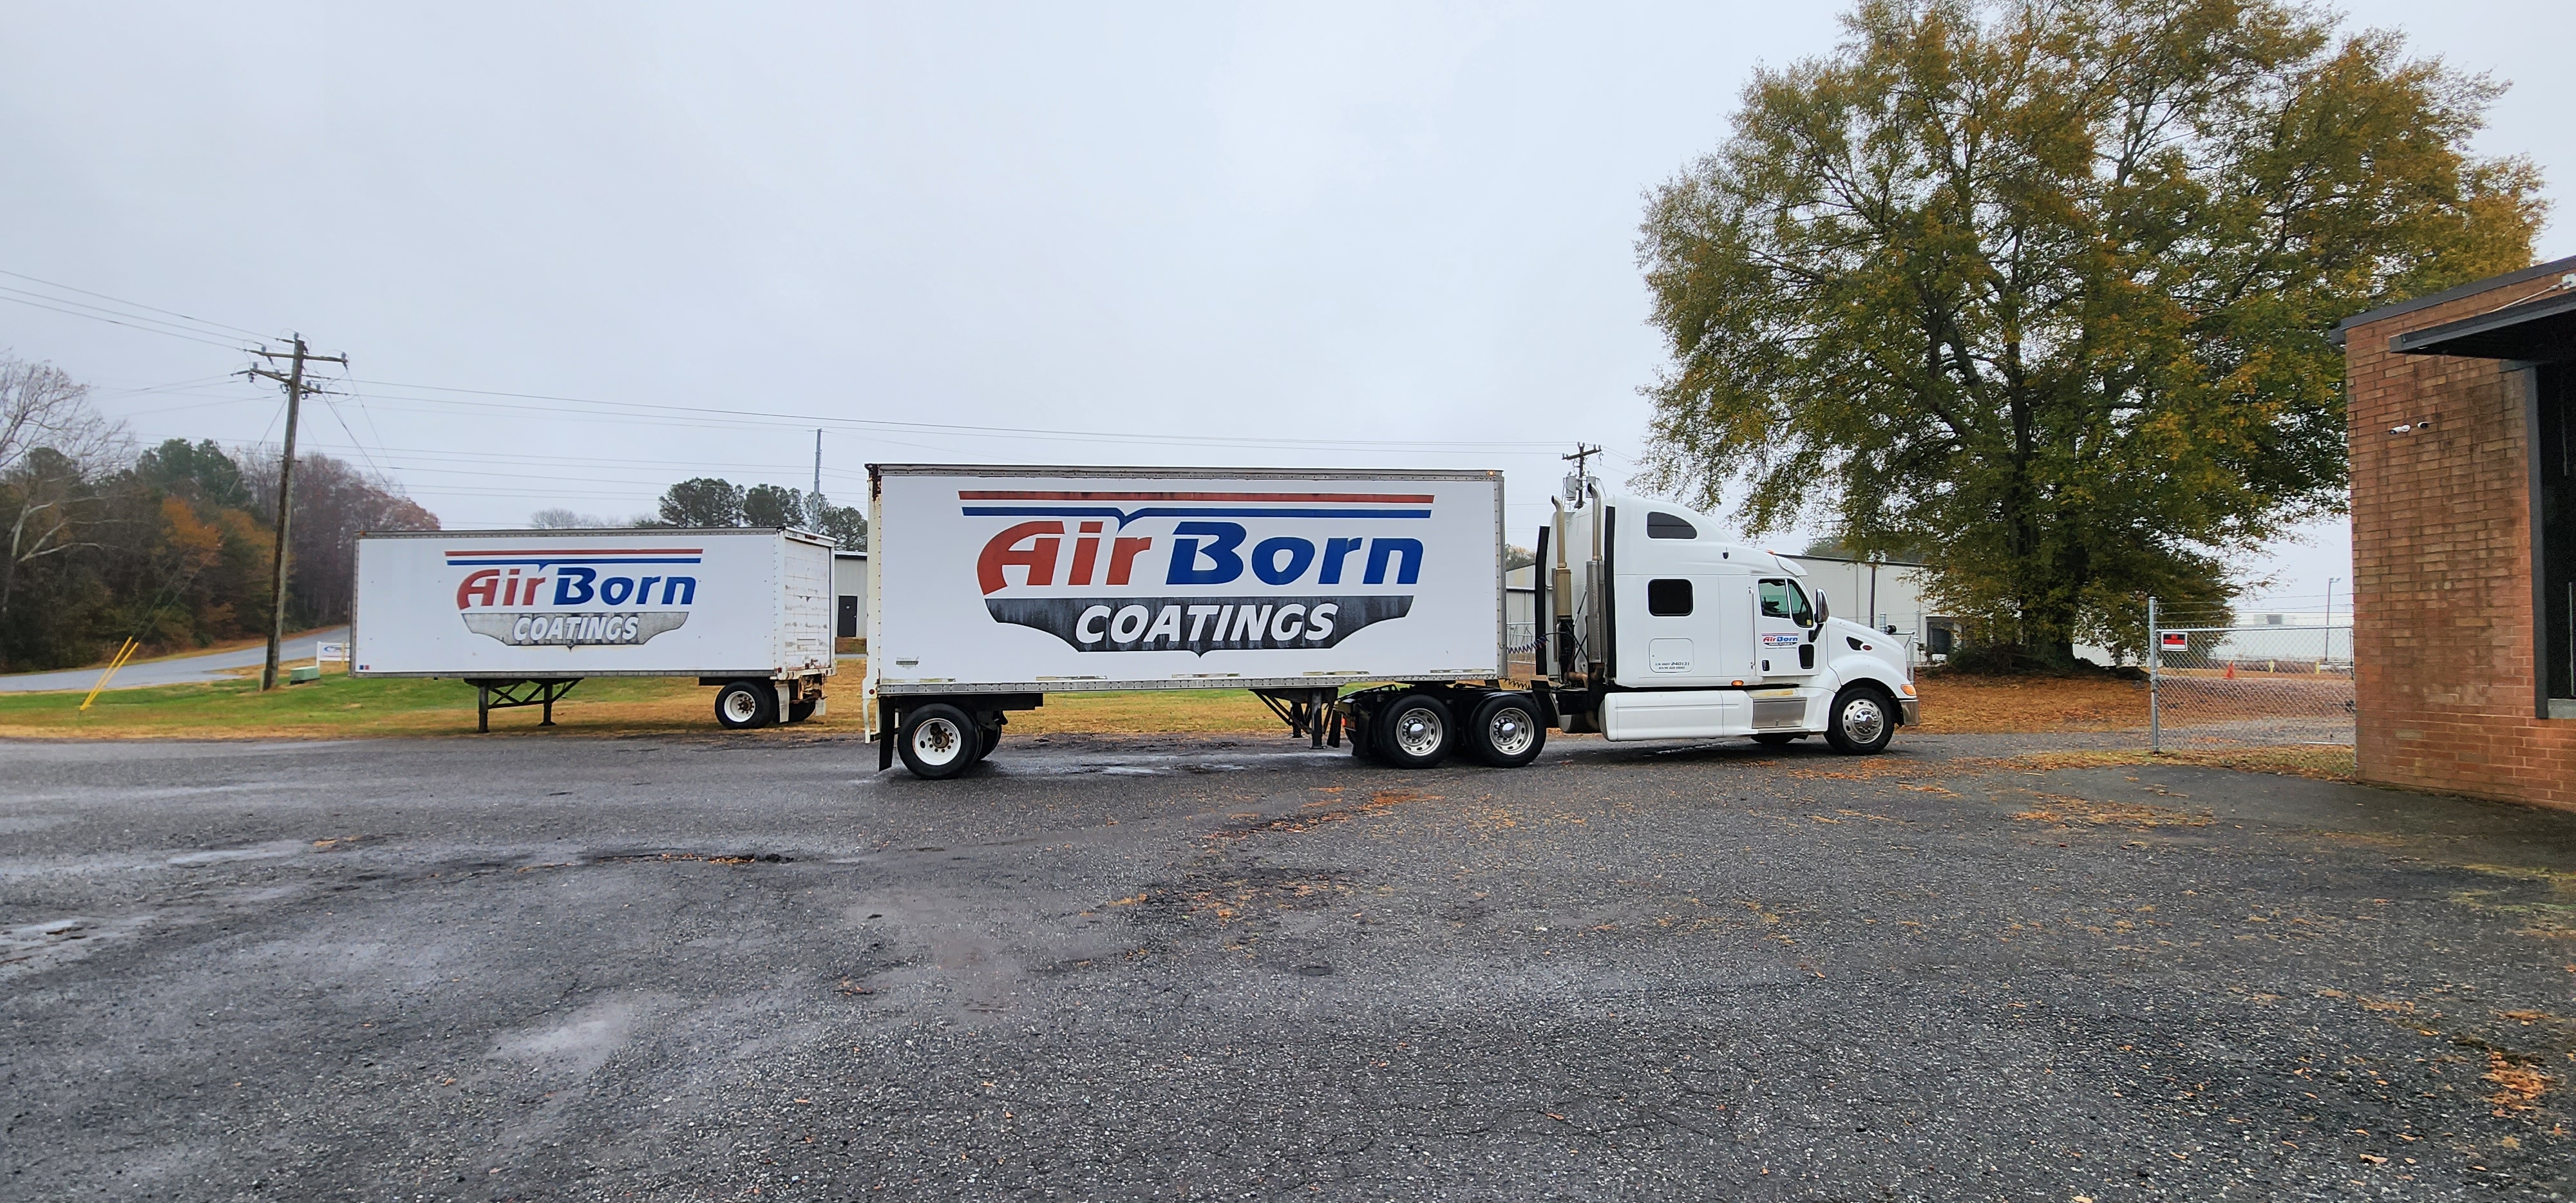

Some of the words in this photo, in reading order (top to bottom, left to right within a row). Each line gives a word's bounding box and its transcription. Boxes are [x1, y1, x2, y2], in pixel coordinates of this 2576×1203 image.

[977, 520, 1153, 596] Air
[1165, 521, 1425, 585] Born
[457, 568, 546, 610] Air
[553, 567, 696, 605] Born
[513, 616, 639, 640] COATINGS
[1075, 603, 1338, 643] COATINGS
